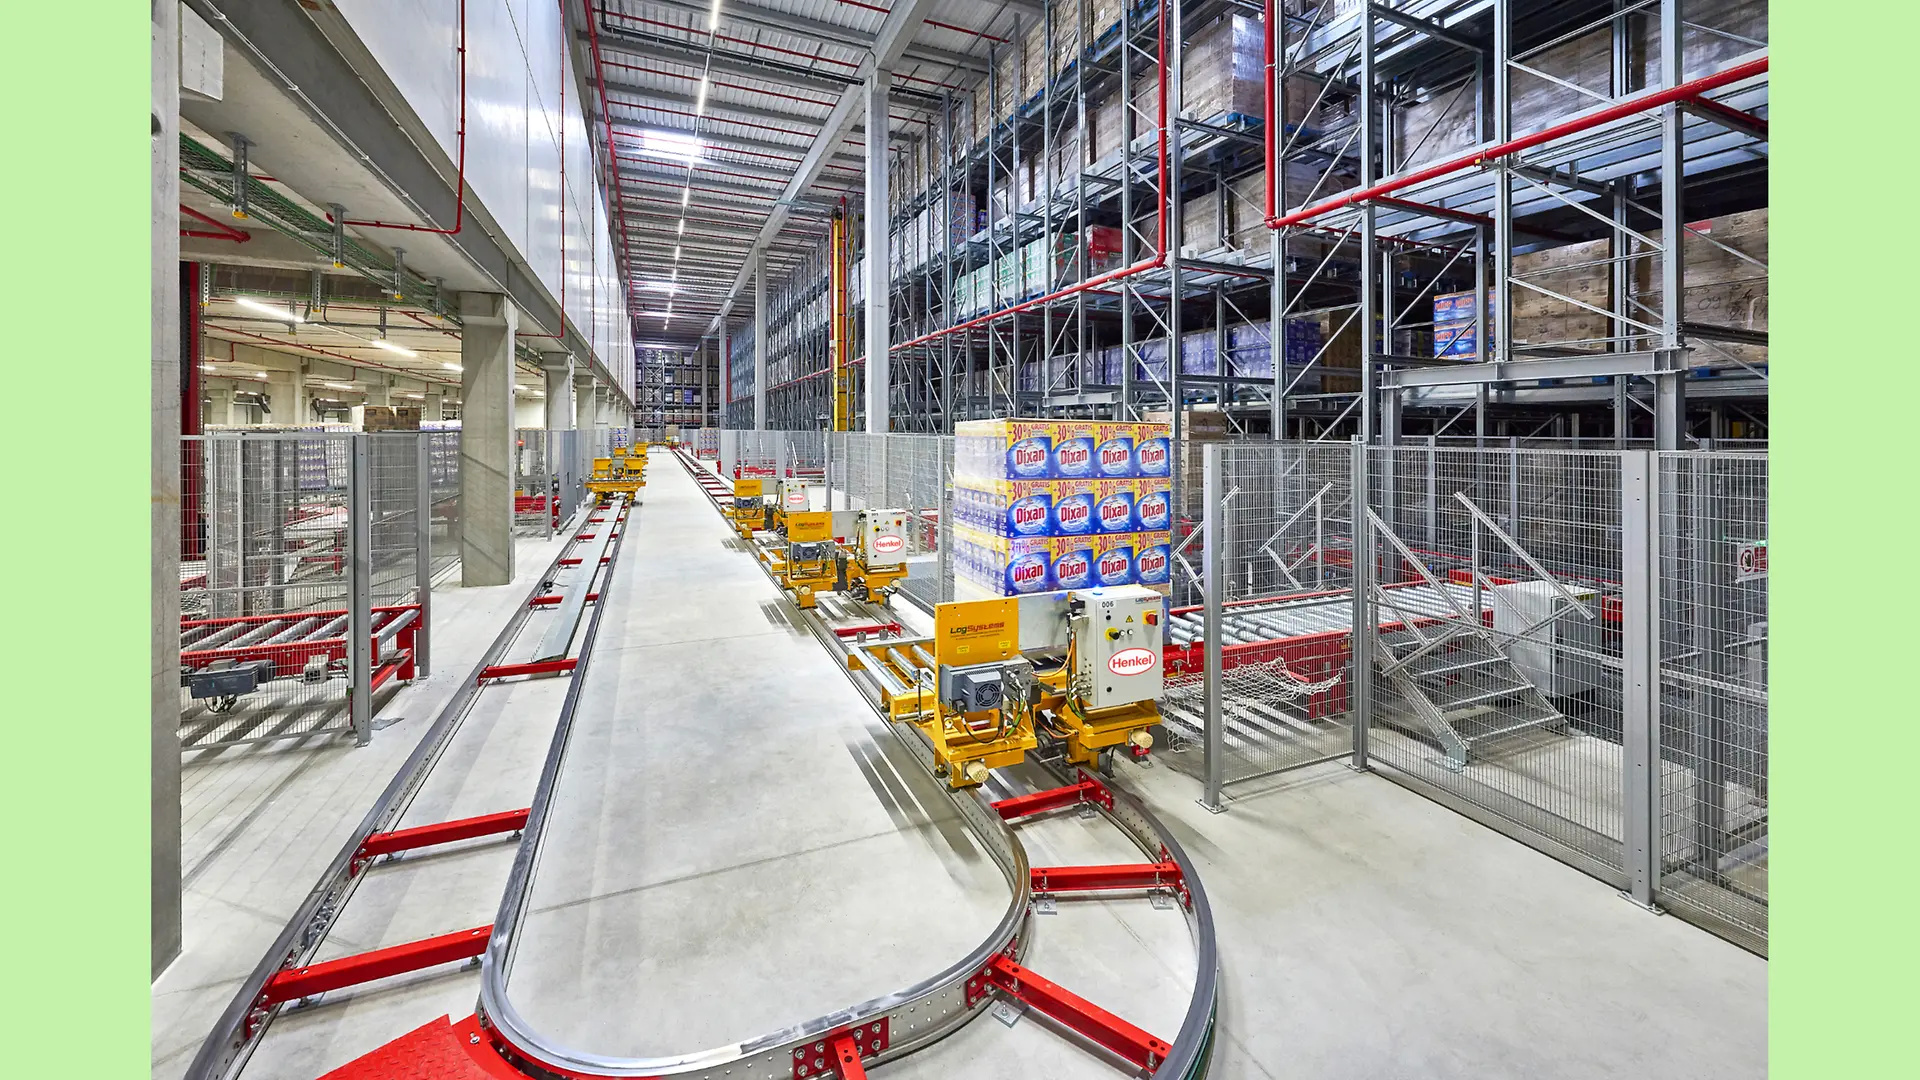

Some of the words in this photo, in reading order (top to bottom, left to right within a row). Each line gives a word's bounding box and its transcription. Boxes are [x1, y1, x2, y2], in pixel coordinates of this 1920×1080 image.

[1016, 449, 1045, 465] Dixan
[1061, 449, 1087, 465] Dixan
[1103, 449, 1127, 464] Dixan
[1141, 449, 1164, 464] Dixan
[1016, 507, 1045, 524] Dixan
[1061, 505, 1087, 522] Dixan
[1103, 504, 1128, 520] Dixan
[1142, 502, 1166, 518] Dixan
[875, 540, 901, 548] Henkel
[1060, 561, 1086, 578] Dixan
[1101, 558, 1127, 575] Dixan
[1141, 556, 1165, 572] Dixan
[1015, 564, 1043, 582] Dixan
[1112, 655, 1152, 669] Henkel
